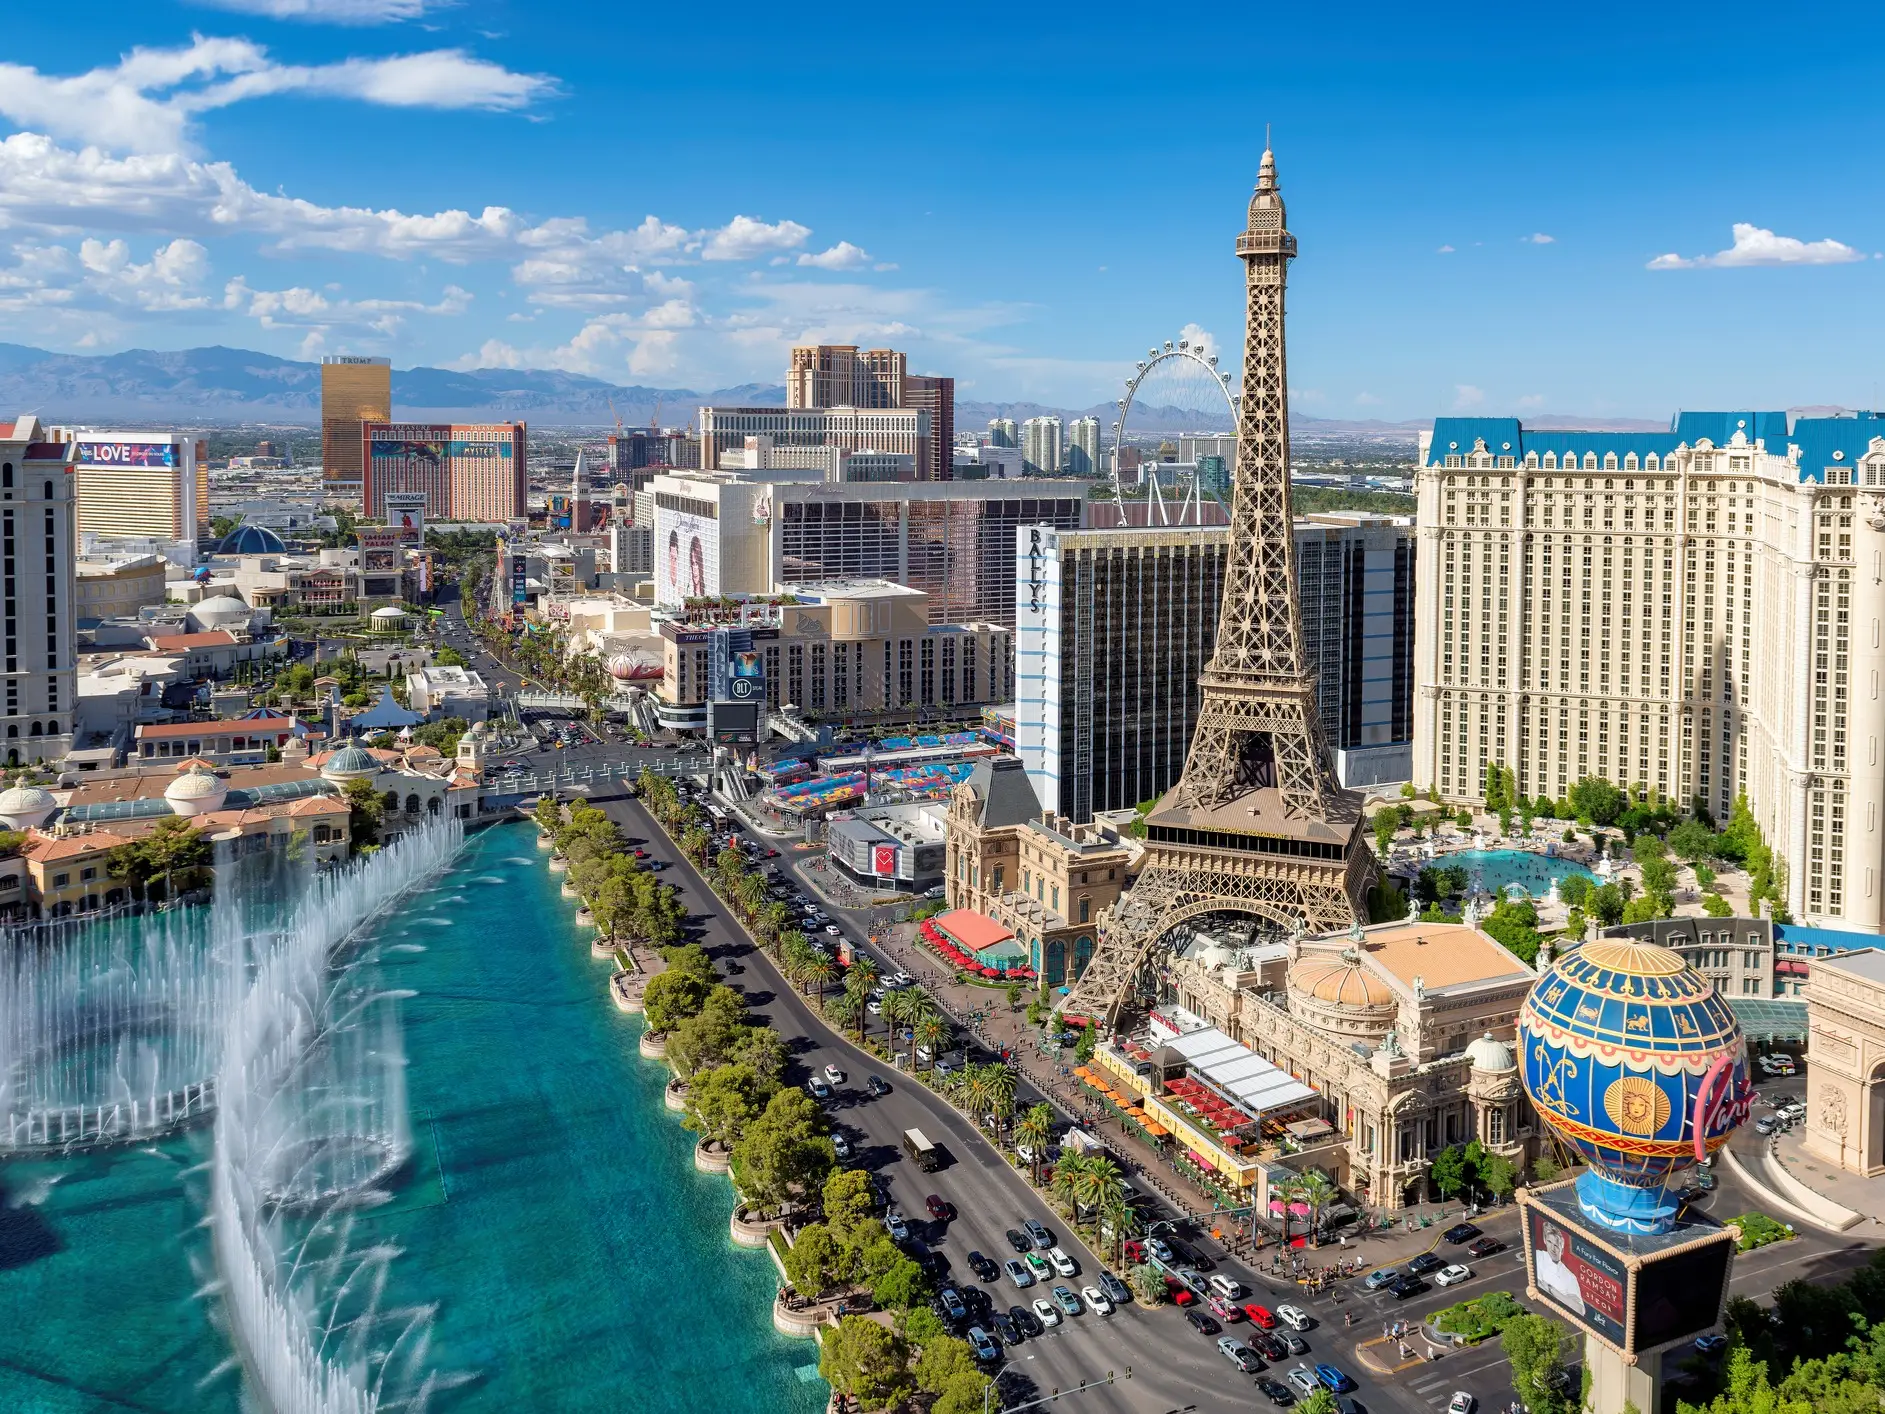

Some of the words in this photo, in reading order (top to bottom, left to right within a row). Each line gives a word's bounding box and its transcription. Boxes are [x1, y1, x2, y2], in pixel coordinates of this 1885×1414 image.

[93, 445, 131, 461] LOVE
[736, 682, 748, 694] BLT
[1581, 1247, 1592, 1260] Fury
[1593, 1254, 1602, 1265] For
[1602, 1260, 1619, 1276] Flavor
[1580, 1264, 1617, 1293] GORDON
[1580, 1273, 1617, 1302] RAMSAY
